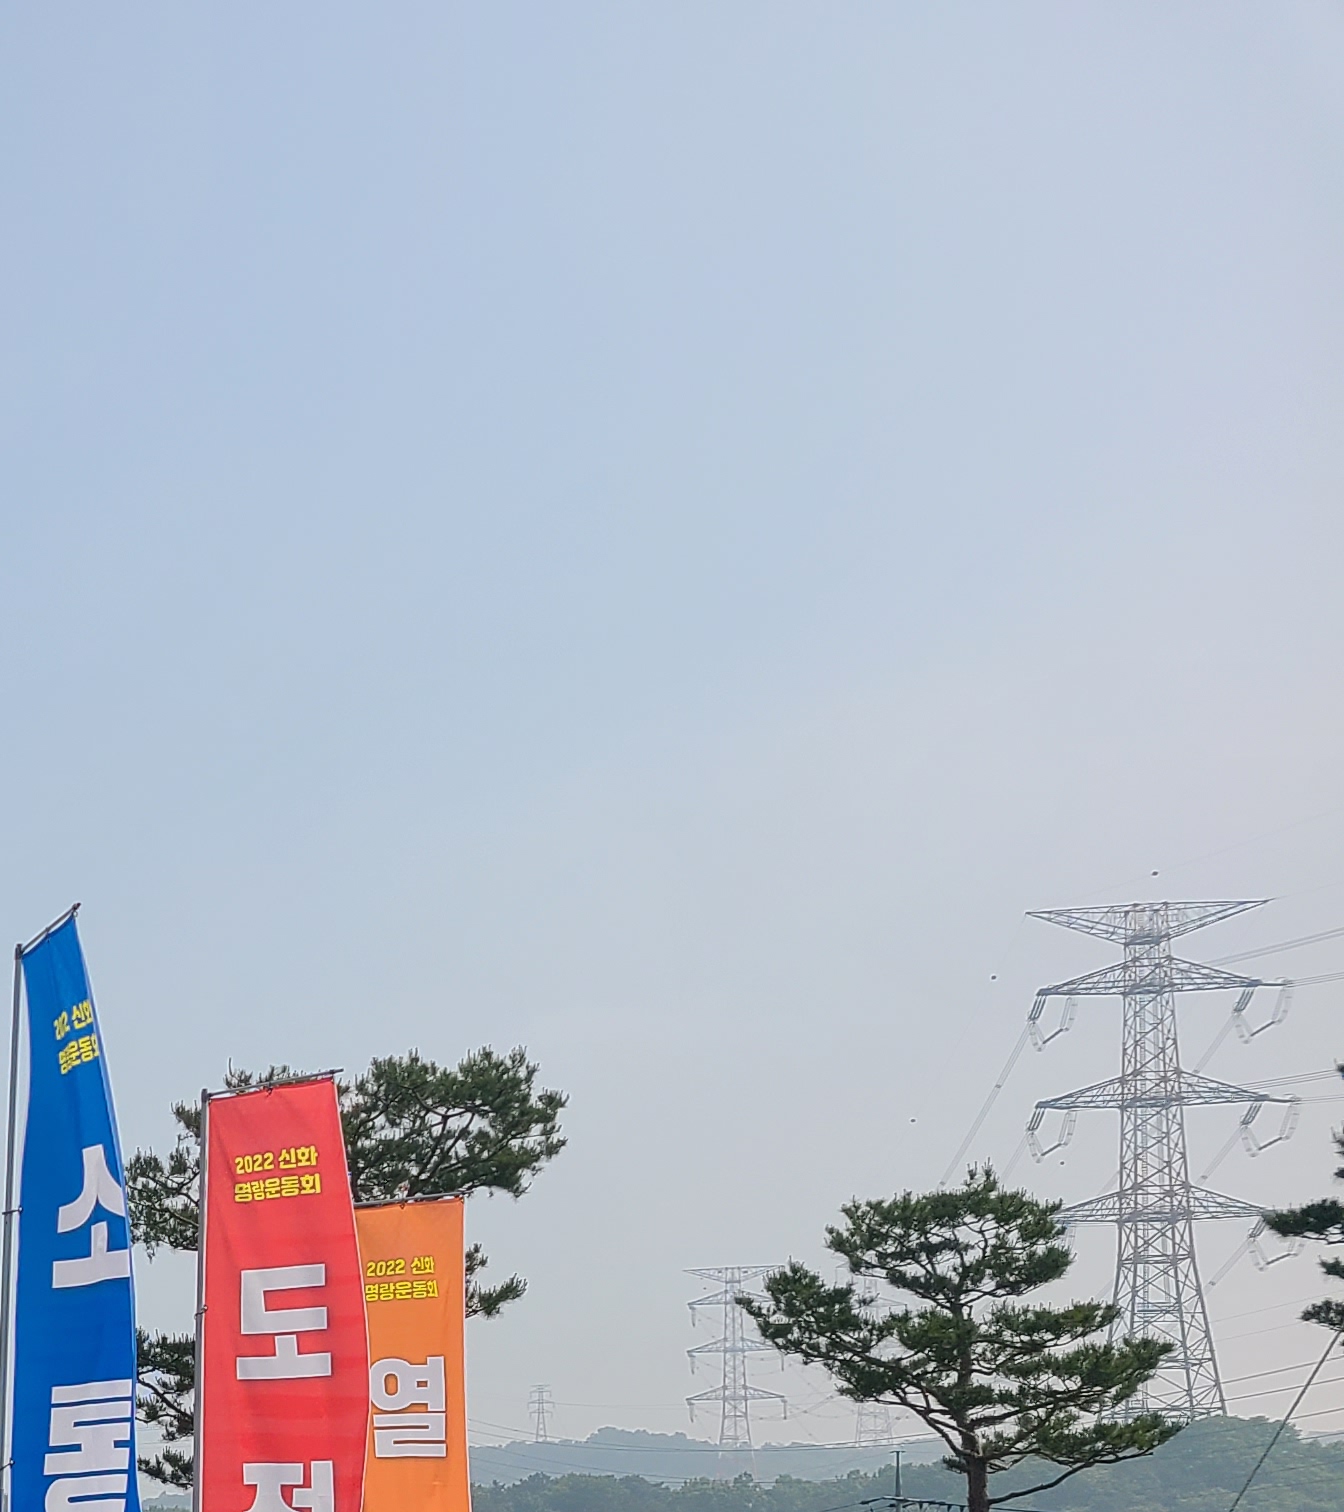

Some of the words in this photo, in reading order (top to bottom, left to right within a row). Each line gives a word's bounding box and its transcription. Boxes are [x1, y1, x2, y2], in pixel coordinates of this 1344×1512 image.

[235, 1152, 274, 1175] 2022
[278, 1145, 318, 1169] 신화
[234, 1173, 321, 1203] 명랑운동회
[366, 1258, 406, 1278] 2022
[410, 1256, 435, 1275] 신화
[365, 1280, 439, 1303] 명랑운동회
